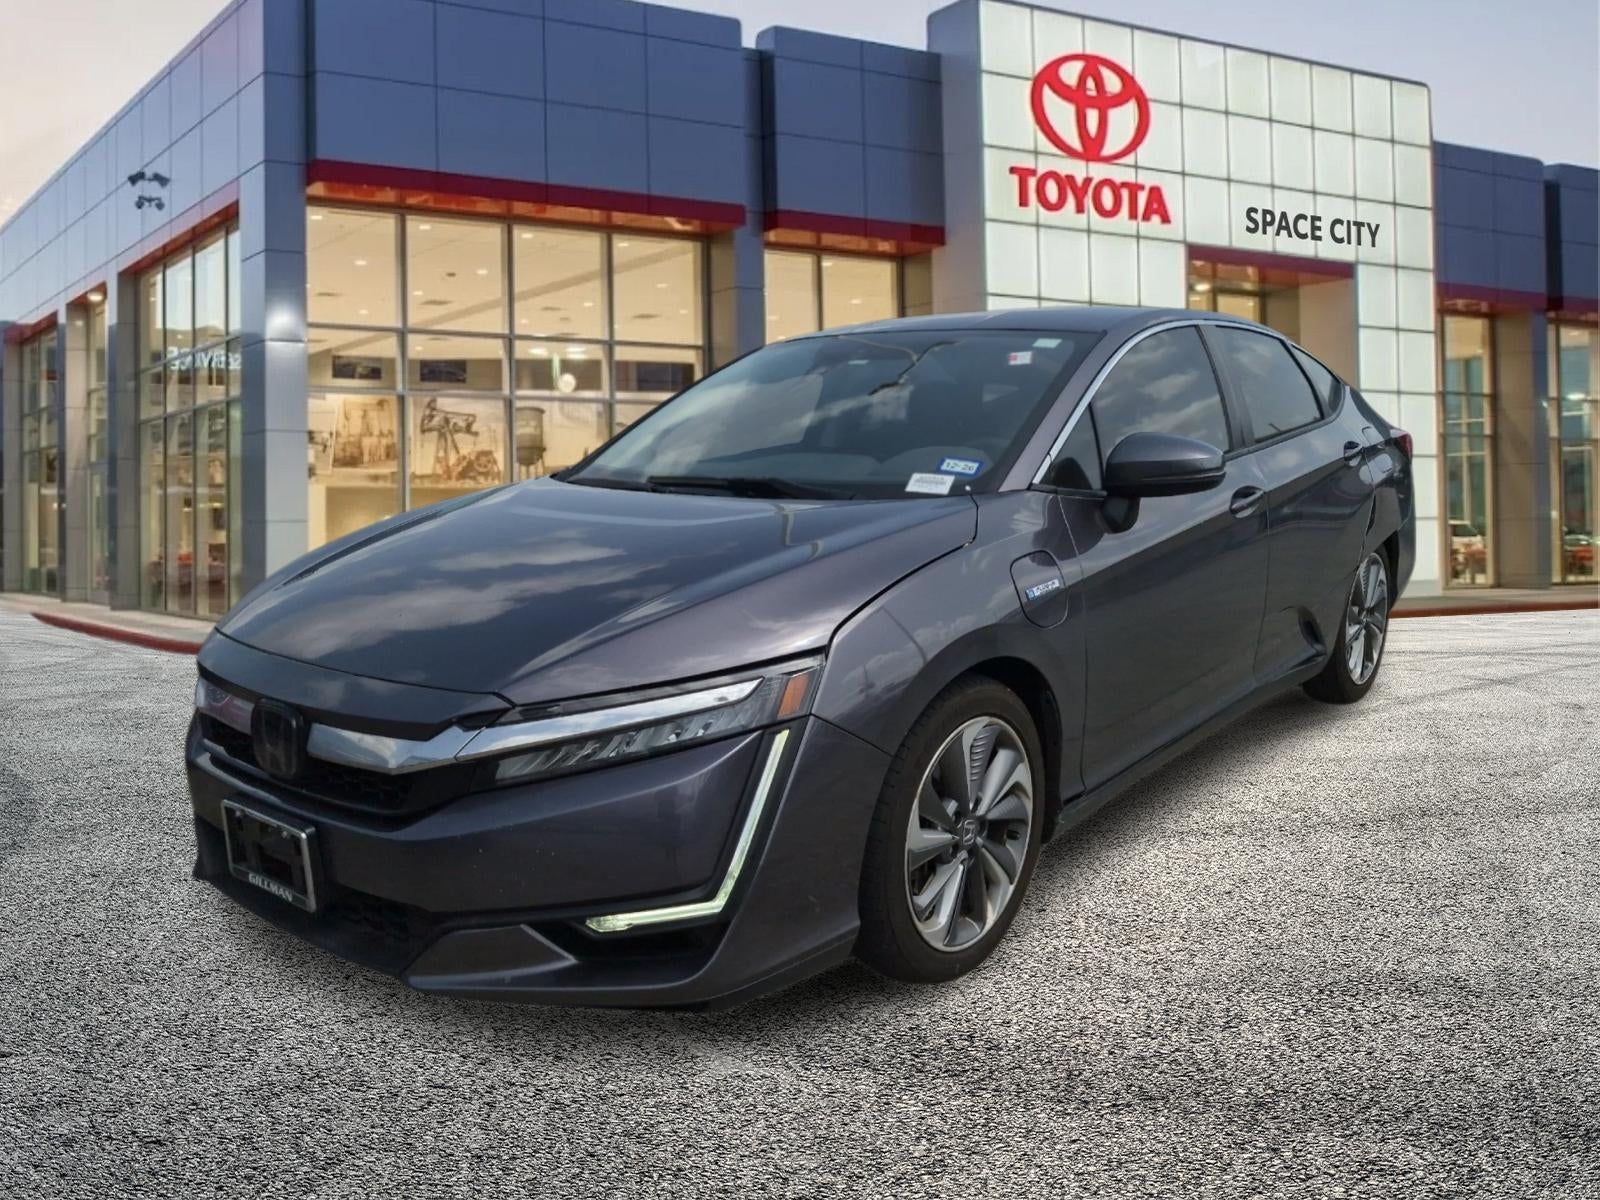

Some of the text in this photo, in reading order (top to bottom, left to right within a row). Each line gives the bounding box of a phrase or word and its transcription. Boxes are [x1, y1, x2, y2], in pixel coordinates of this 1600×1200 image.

[1009, 165, 1171, 225] TOYOTA
[1245, 206, 1381, 248] SPACE CITY
[248, 872, 293, 902] GILLMAN
